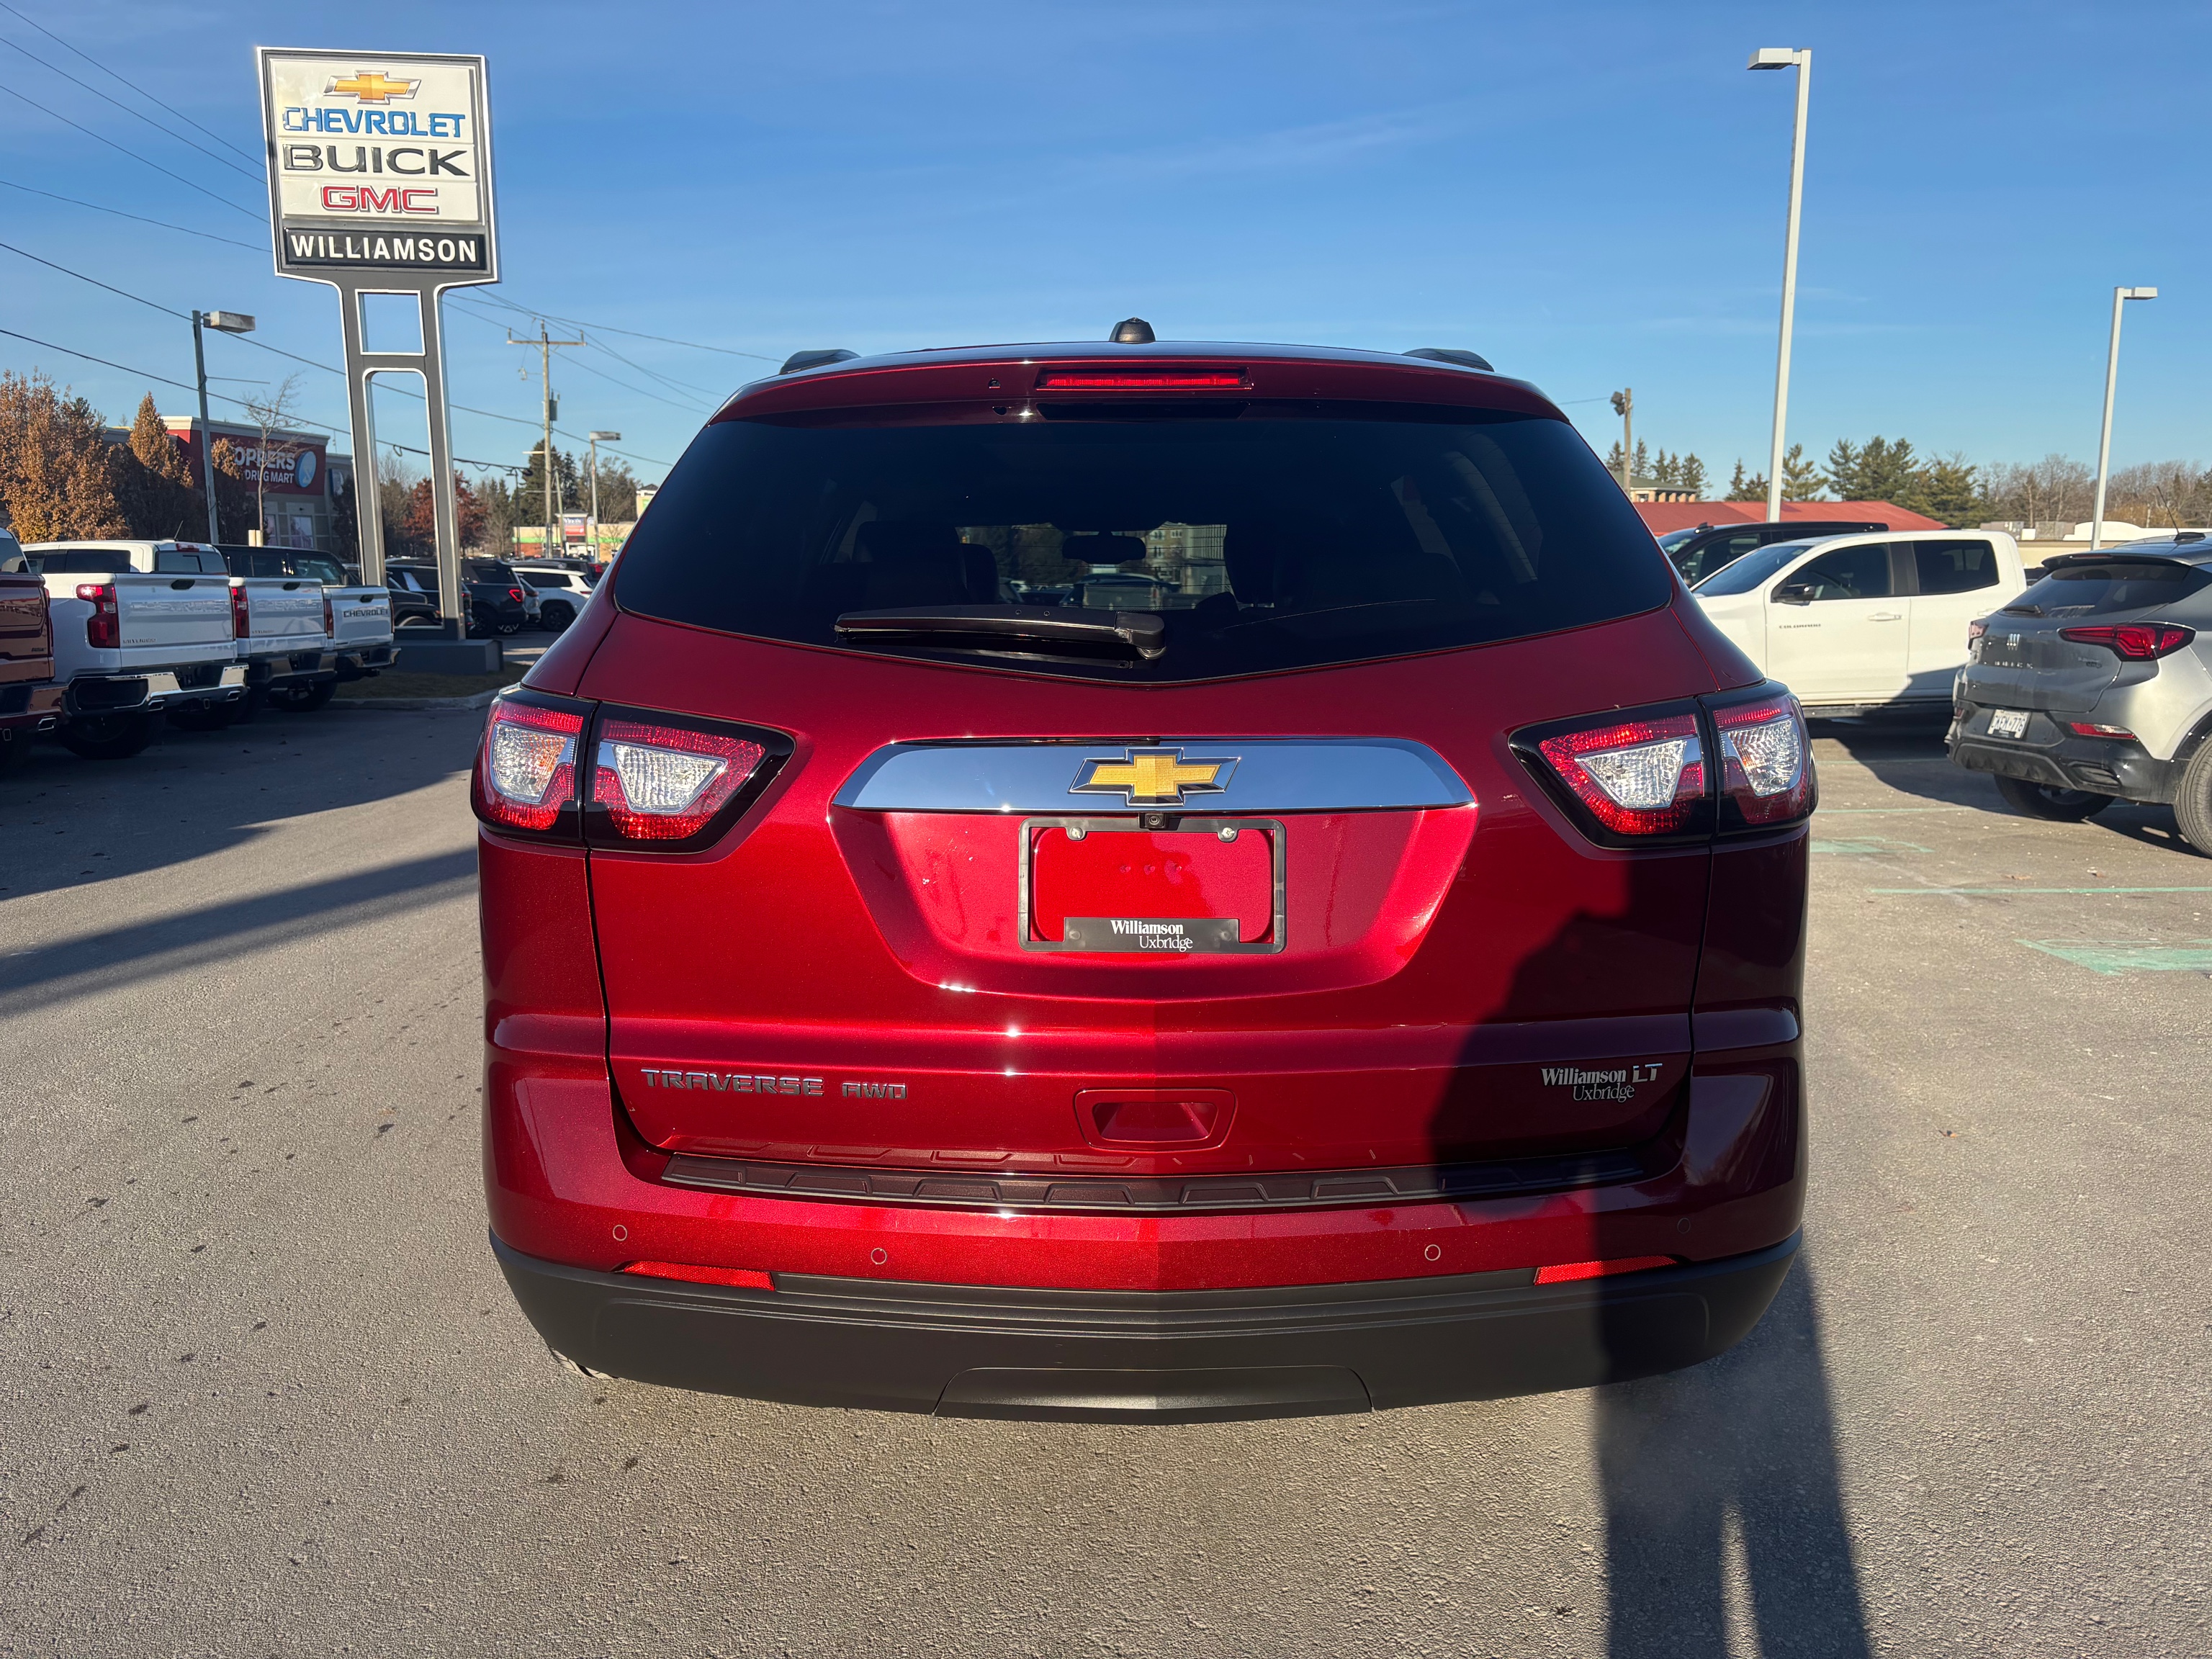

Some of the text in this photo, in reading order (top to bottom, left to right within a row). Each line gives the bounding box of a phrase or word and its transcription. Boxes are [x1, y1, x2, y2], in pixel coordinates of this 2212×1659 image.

[282, 107, 466, 138] CHEVROLET
[282, 143, 471, 177] BUICK
[321, 185, 440, 215] GMC
[290, 235, 477, 263] WILLIAMSON
[234, 446, 296, 471] OPPERS
[270, 472, 295, 484] MART
[343, 608, 389, 618] CHEVROLET
[1110, 920, 1184, 935] Williamson
[1139, 935, 1194, 952] Uxbridge
[640, 1068, 908, 1100] TRAVERSE AWD
[1541, 1067, 1627, 1087] Williamson
[1632, 1063, 1663, 1084] LT
[1573, 1082, 1635, 1103] Uxbridge
